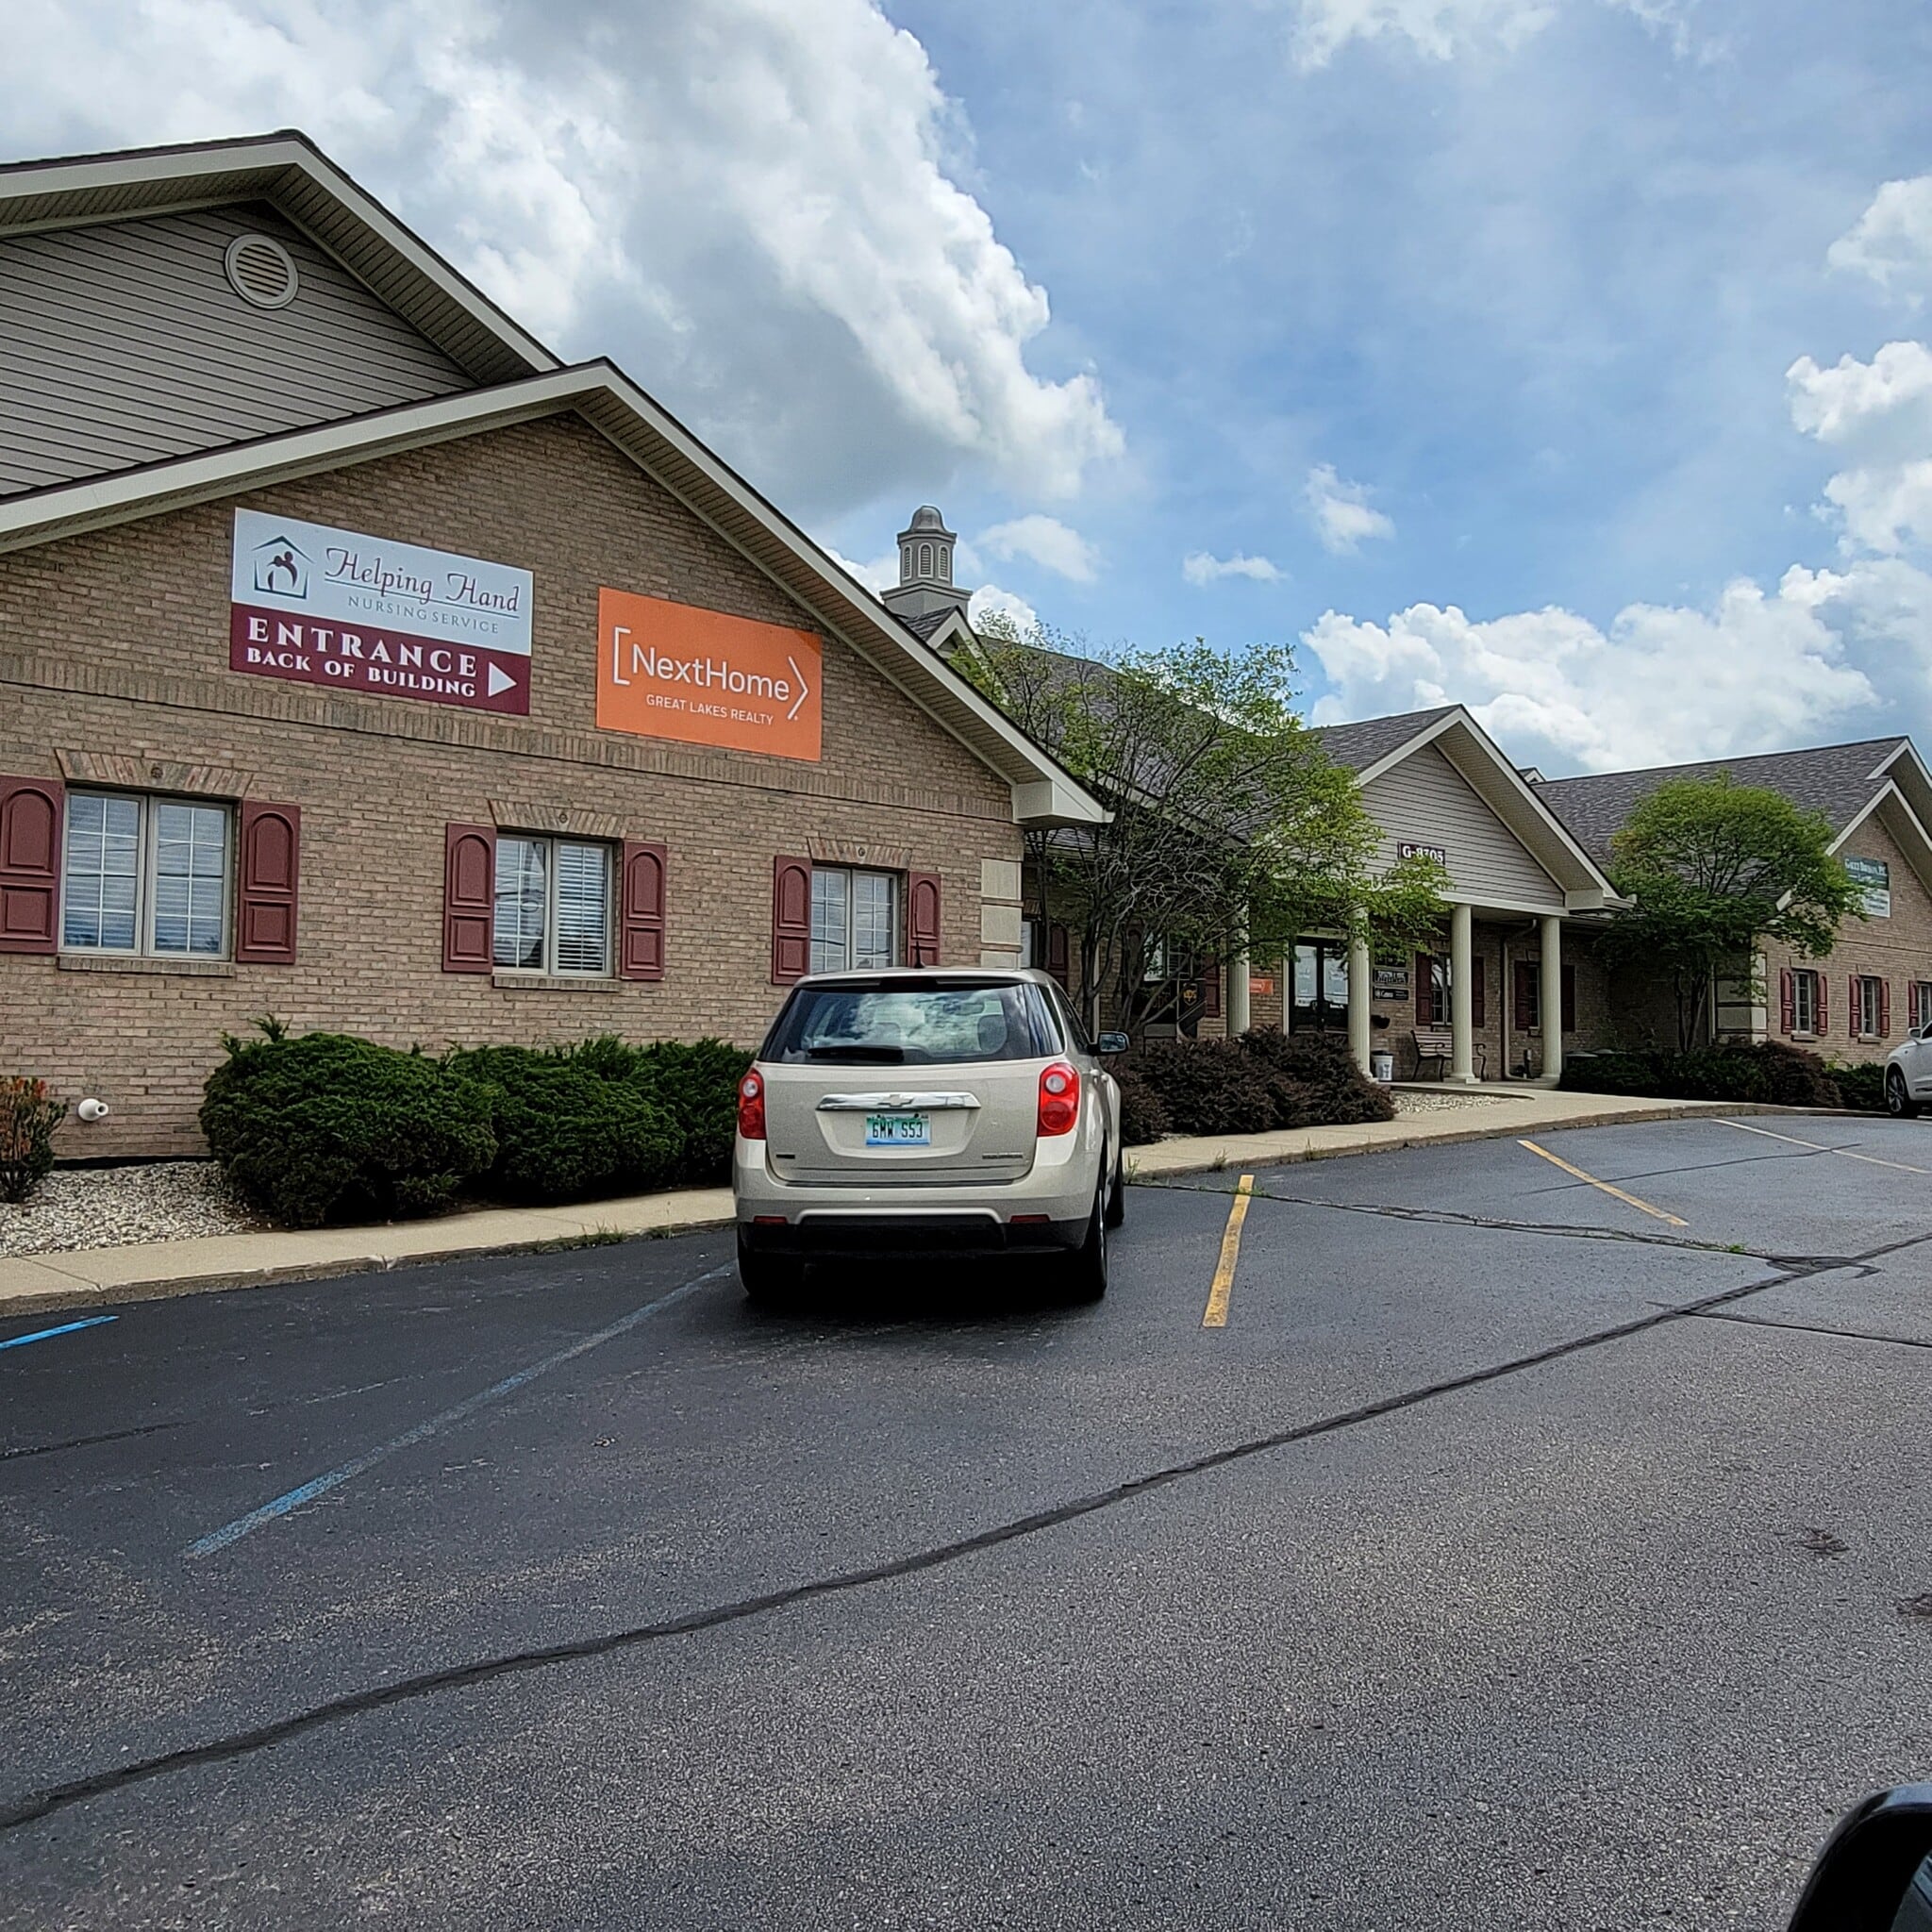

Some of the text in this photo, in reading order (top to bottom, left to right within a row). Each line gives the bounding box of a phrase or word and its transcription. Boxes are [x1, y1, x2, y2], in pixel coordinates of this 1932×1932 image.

[325, 547, 520, 612] Helping Hand
[348, 596, 499, 634] NURSING SERVICE
[247, 647, 476, 698] BACK OF BUILDING
[248, 616, 477, 678] ENTRANCE
[631, 642, 791, 702] NextHome
[646, 693, 774, 726] GREAT LAKES REALTY
